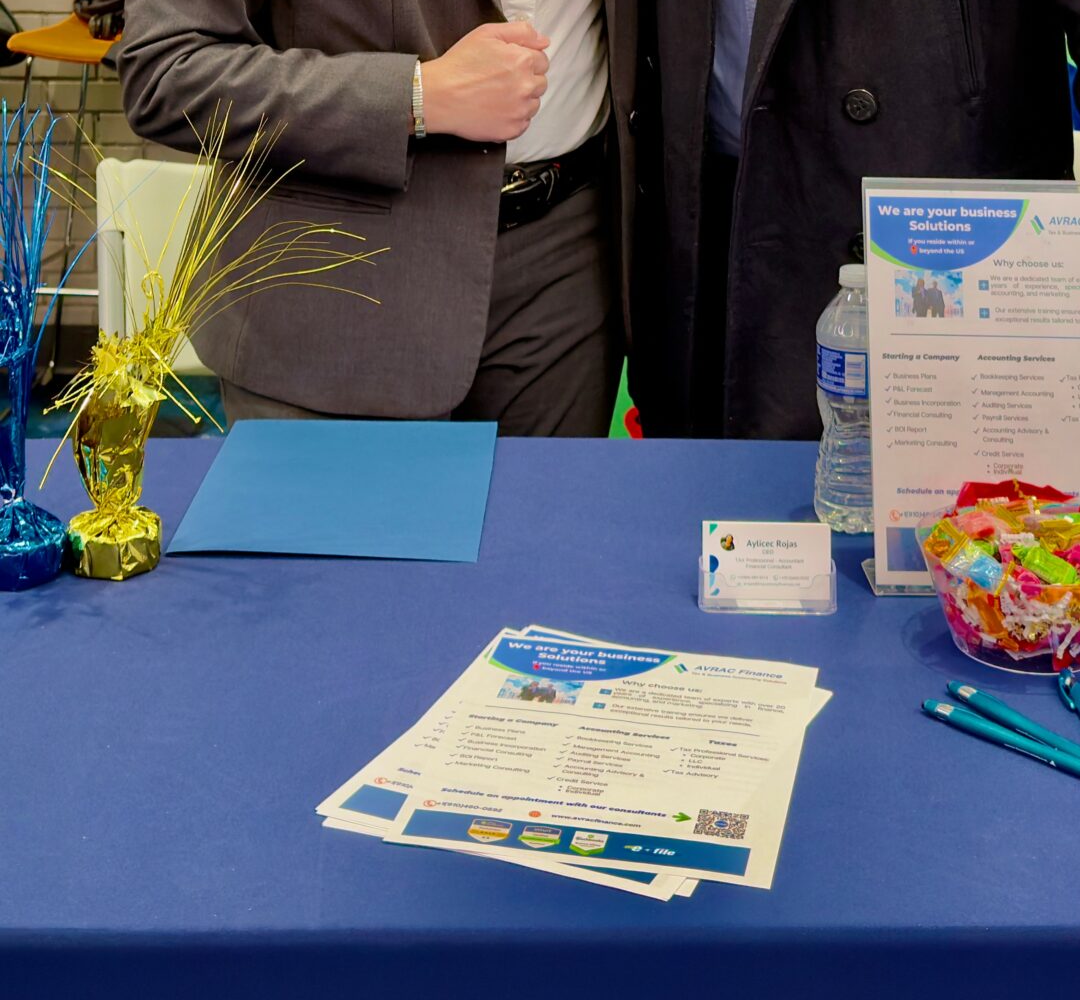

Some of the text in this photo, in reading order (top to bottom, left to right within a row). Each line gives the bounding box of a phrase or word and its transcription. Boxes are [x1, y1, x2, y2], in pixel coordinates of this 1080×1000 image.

[878, 205, 1017, 218] We are your business
[909, 221, 971, 232] Solutions
[993, 259, 1013, 268] Why
[882, 353, 914, 361] Starting
[776, 540, 797, 548] Rojas
[508, 641, 532, 649] We
[561, 647, 595, 656] your
[597, 652, 660, 663] business
[538, 652, 606, 664] Solutions
[694, 665, 735, 673] AVRAC
[738, 669, 783, 679] Finance
[622, 680, 646, 688] Why
[648, 683, 685, 691] choose
[440, 787, 484, 797] Schedule
[501, 794, 564, 808] appointment
[566, 800, 588, 809] with
[608, 806, 667, 818] consultants
